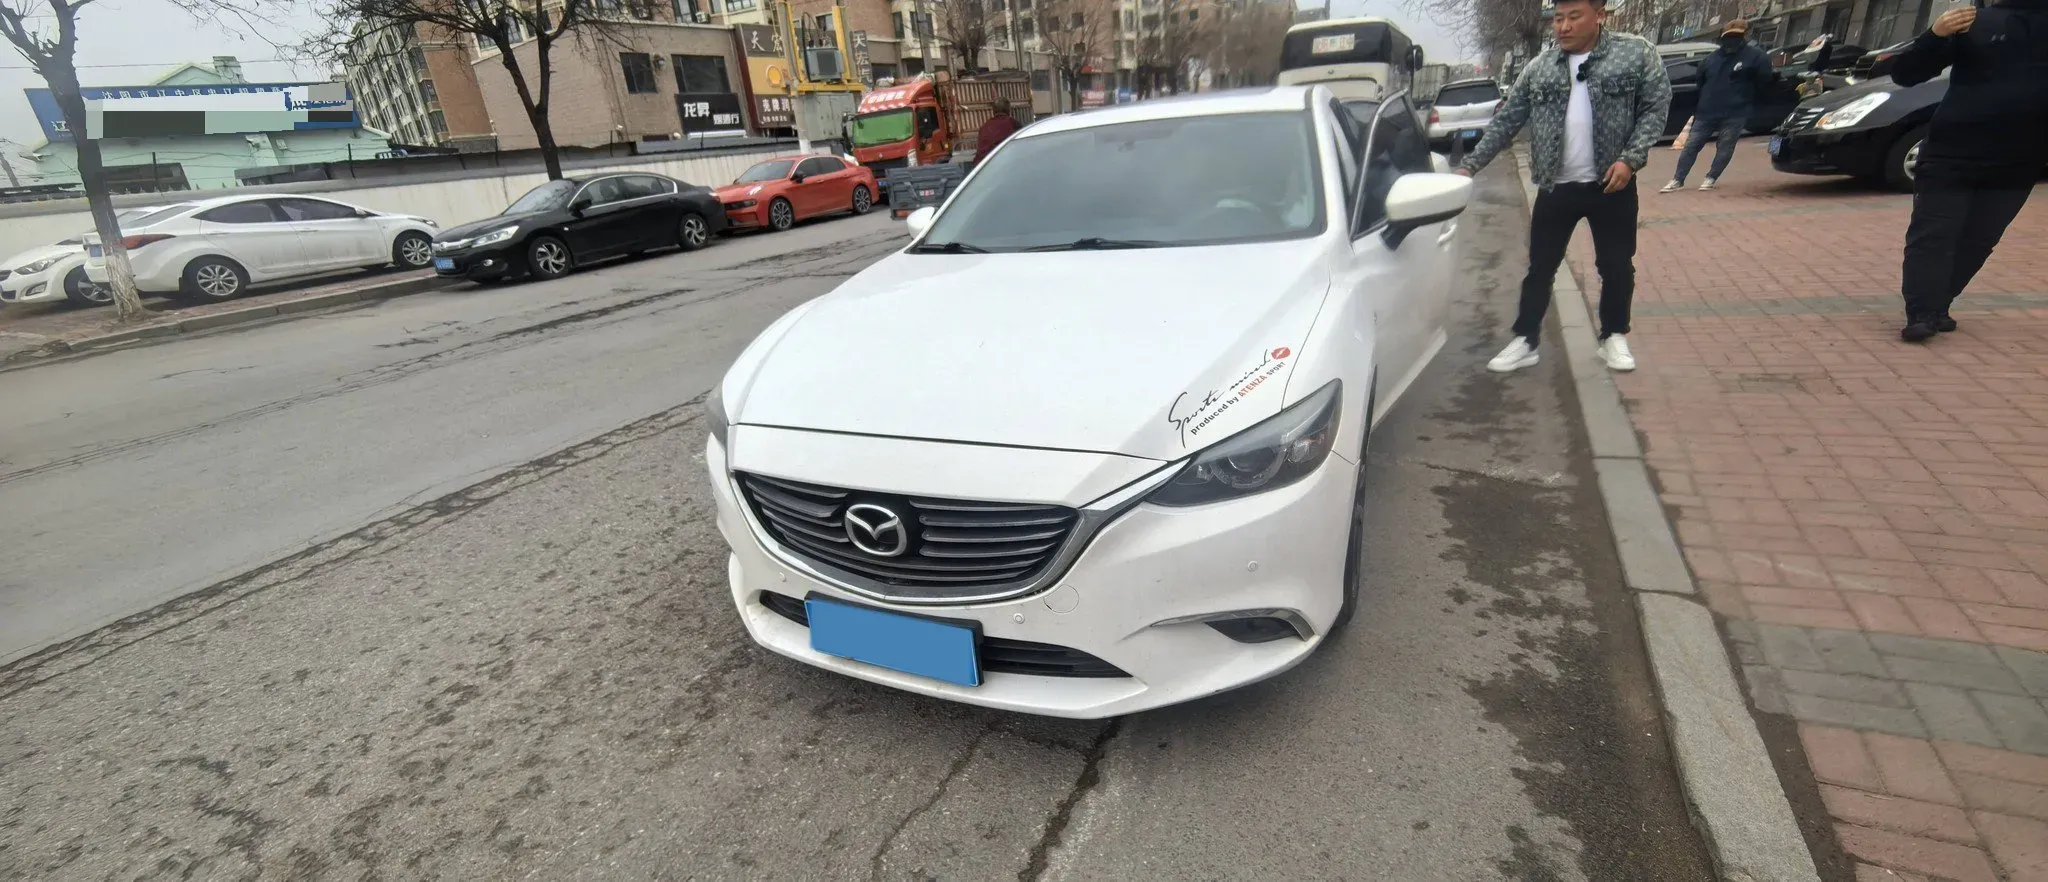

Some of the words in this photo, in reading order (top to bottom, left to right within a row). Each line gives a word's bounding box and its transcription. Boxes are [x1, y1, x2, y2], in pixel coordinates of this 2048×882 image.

[1190, 403, 1229, 436] produced
[1228, 395, 1240, 406] by
[1238, 374, 1268, 397] ATENZA
[1266, 361, 1286, 376] SPORT
